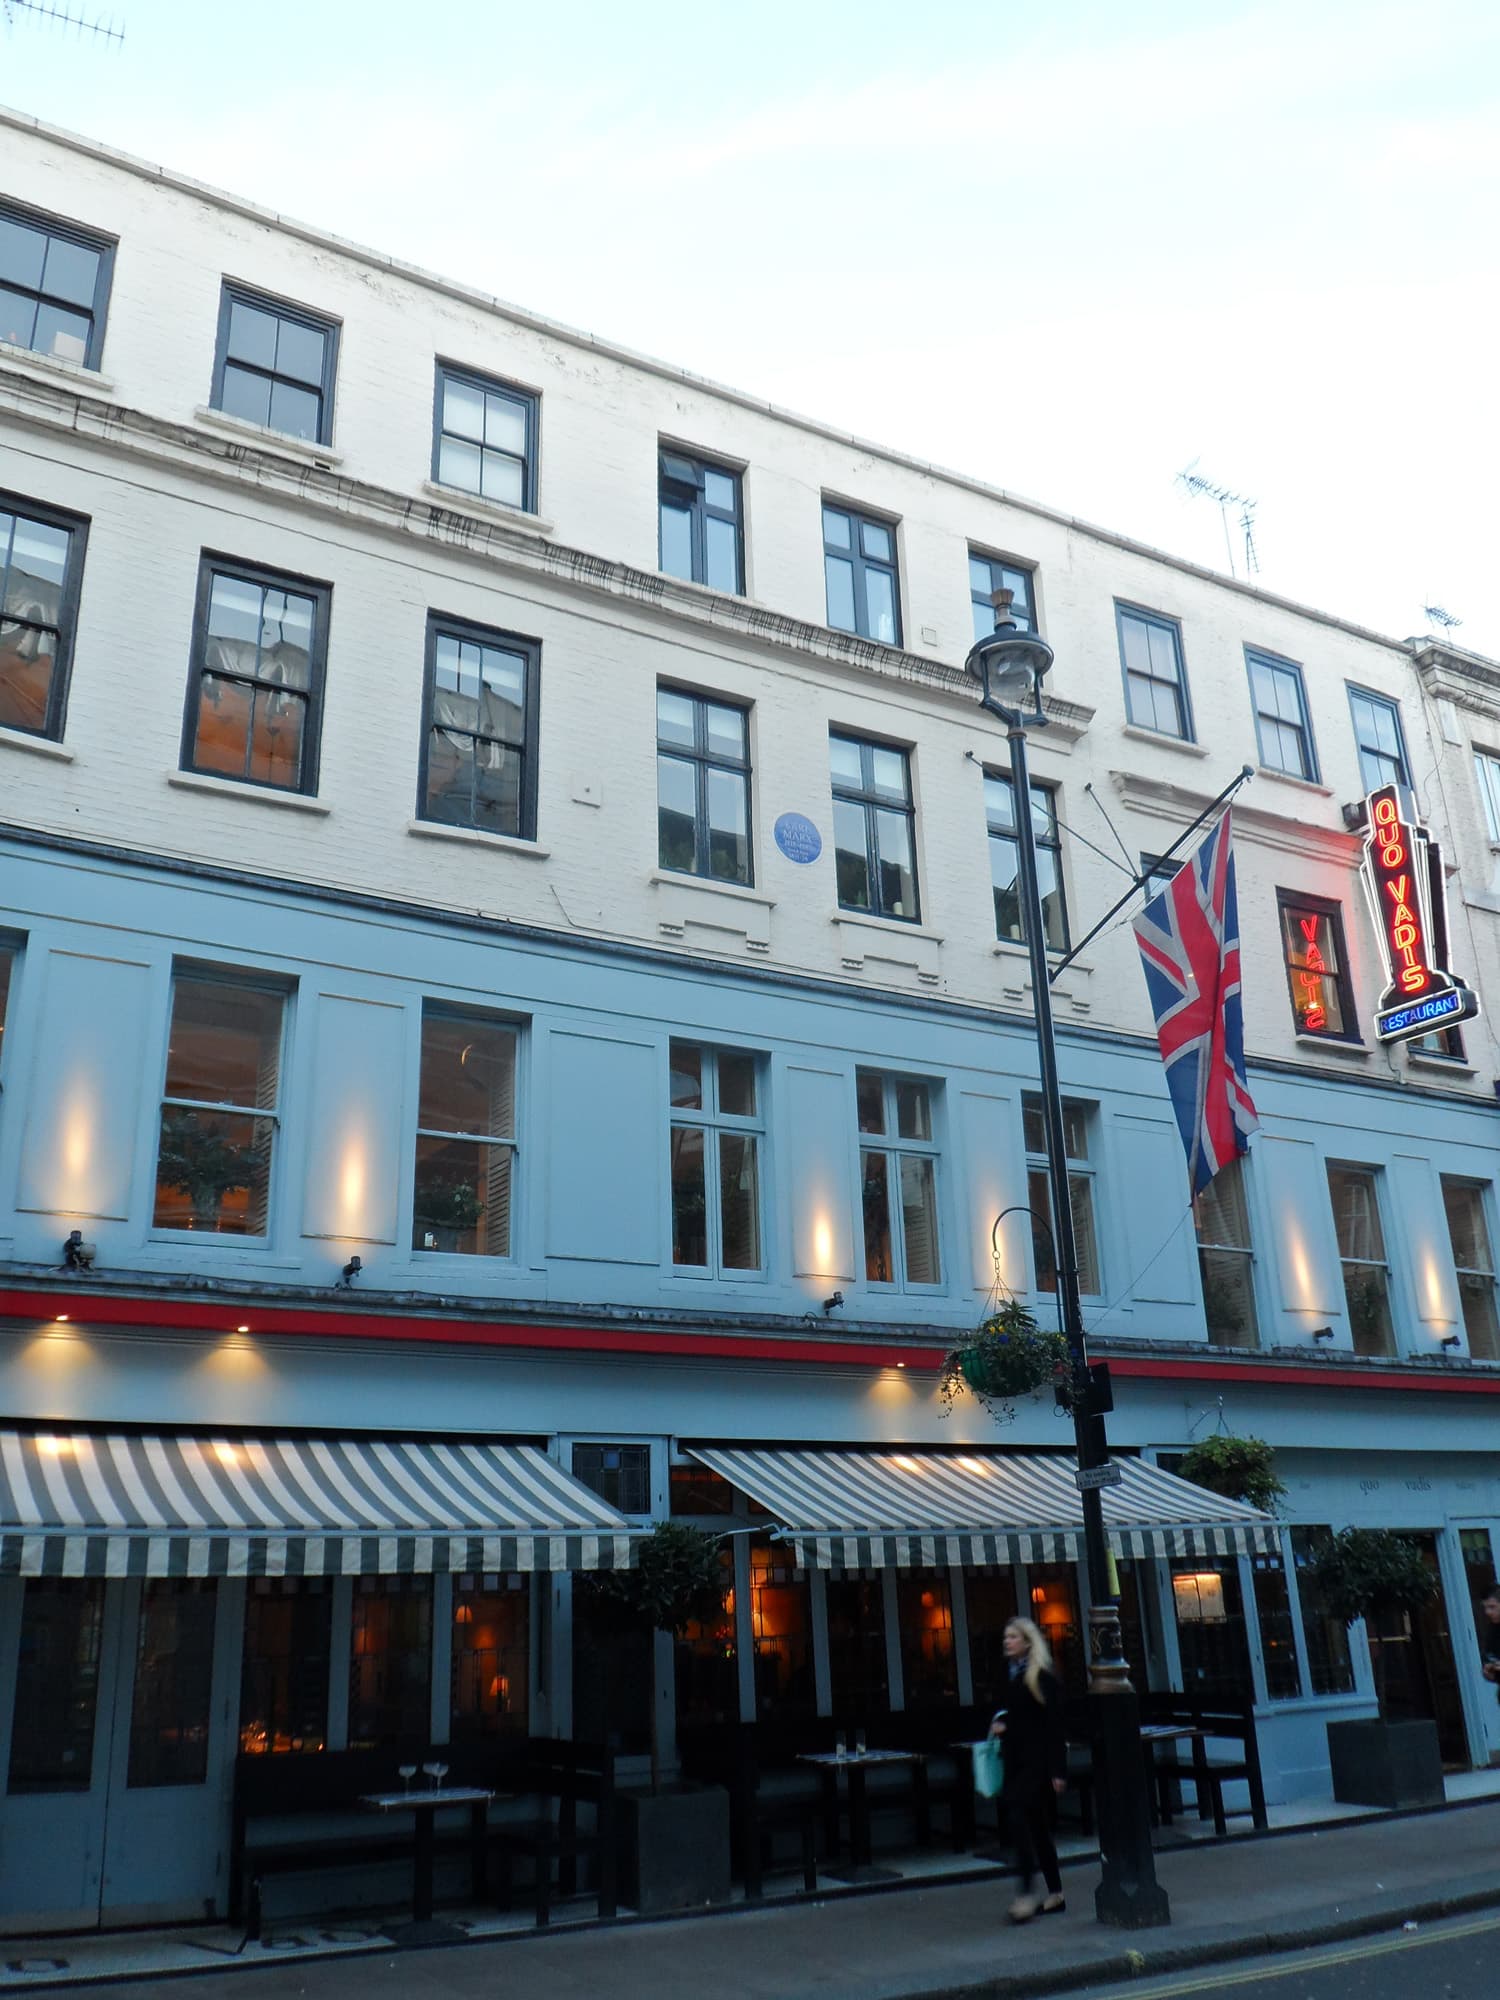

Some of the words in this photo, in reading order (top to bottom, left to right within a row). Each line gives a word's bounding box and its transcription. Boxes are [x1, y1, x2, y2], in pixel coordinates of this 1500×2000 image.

[1375, 798, 1403, 867] QUO
[1388, 875, 1425, 991] VADIS
[1380, 993, 1459, 1033] RESTAURANT
[1360, 1479, 1380, 1496] quo
[1405, 1476, 1432, 1492] vadis
